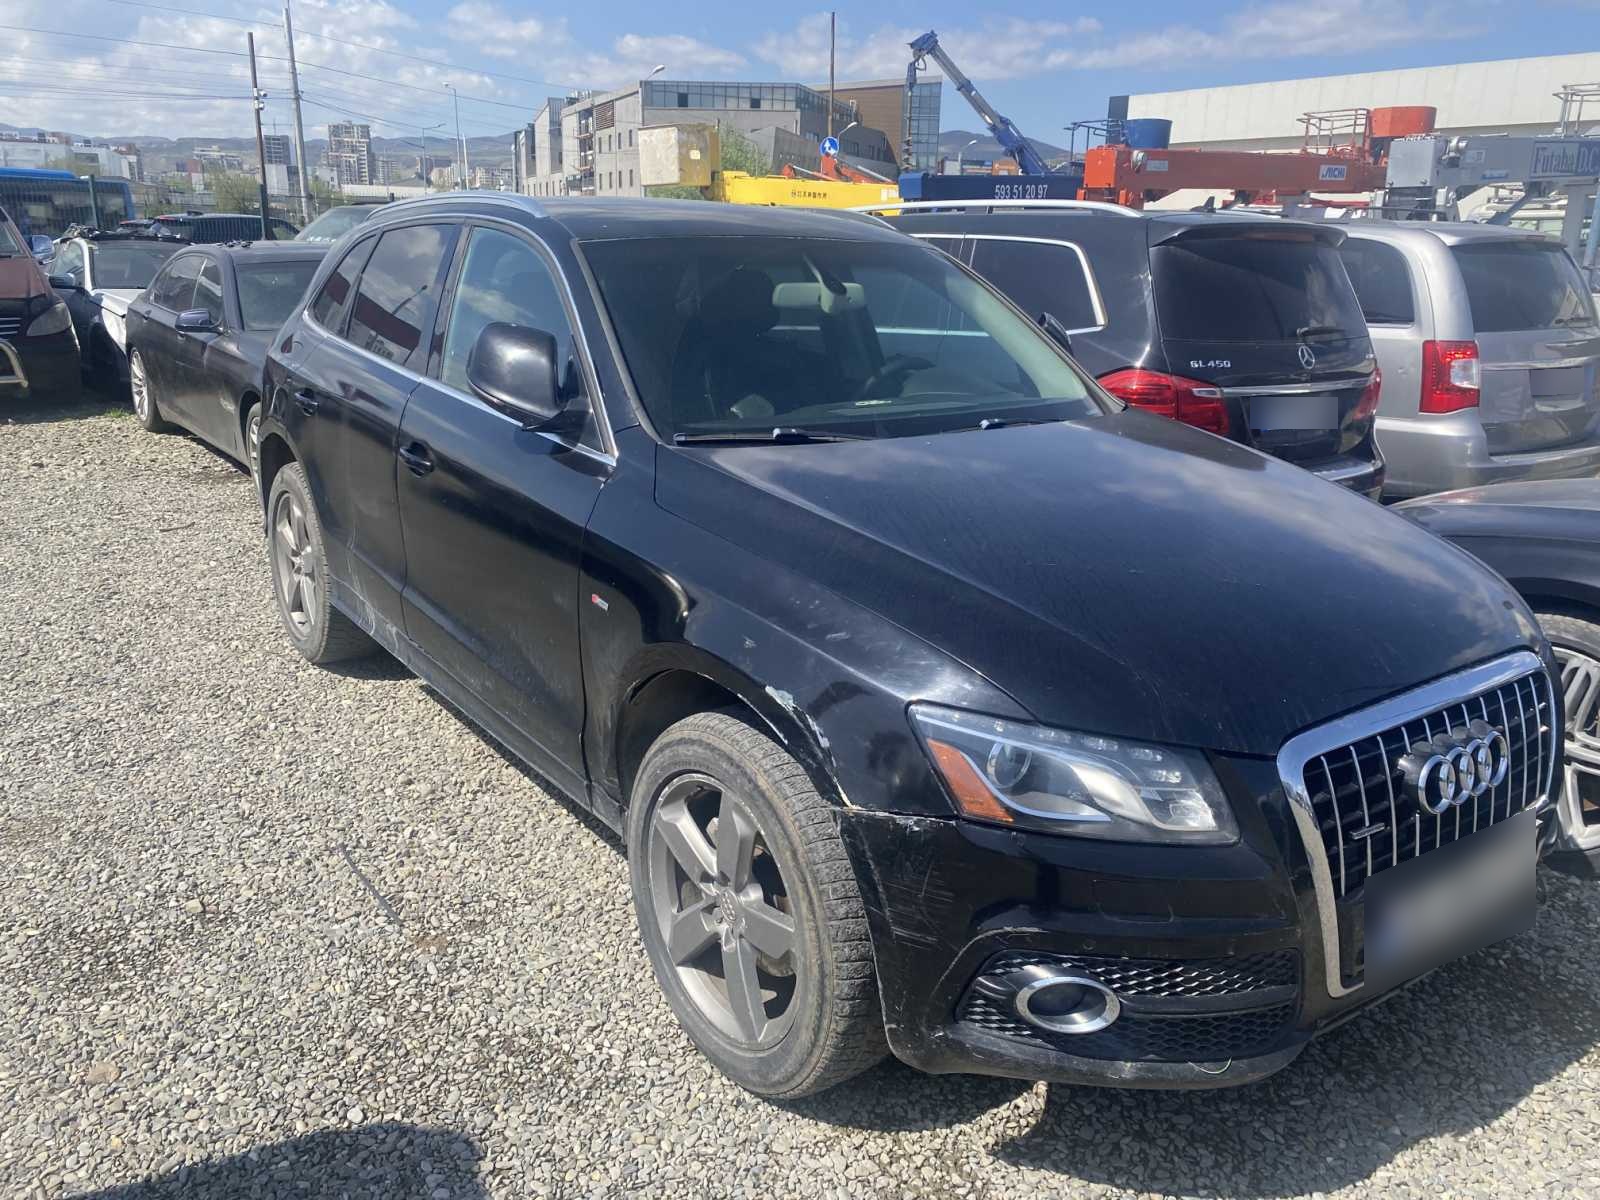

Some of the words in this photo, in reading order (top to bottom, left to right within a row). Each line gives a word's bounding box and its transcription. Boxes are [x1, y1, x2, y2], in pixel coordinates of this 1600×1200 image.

[995, 184, 1011, 199] 593
[1013, 184, 1023, 199] 51
[1025, 184, 1036, 199] 20
[1037, 184, 1048, 199] 97
[1190, 360, 1206, 368] GL
[1208, 360, 1231, 368] 450
